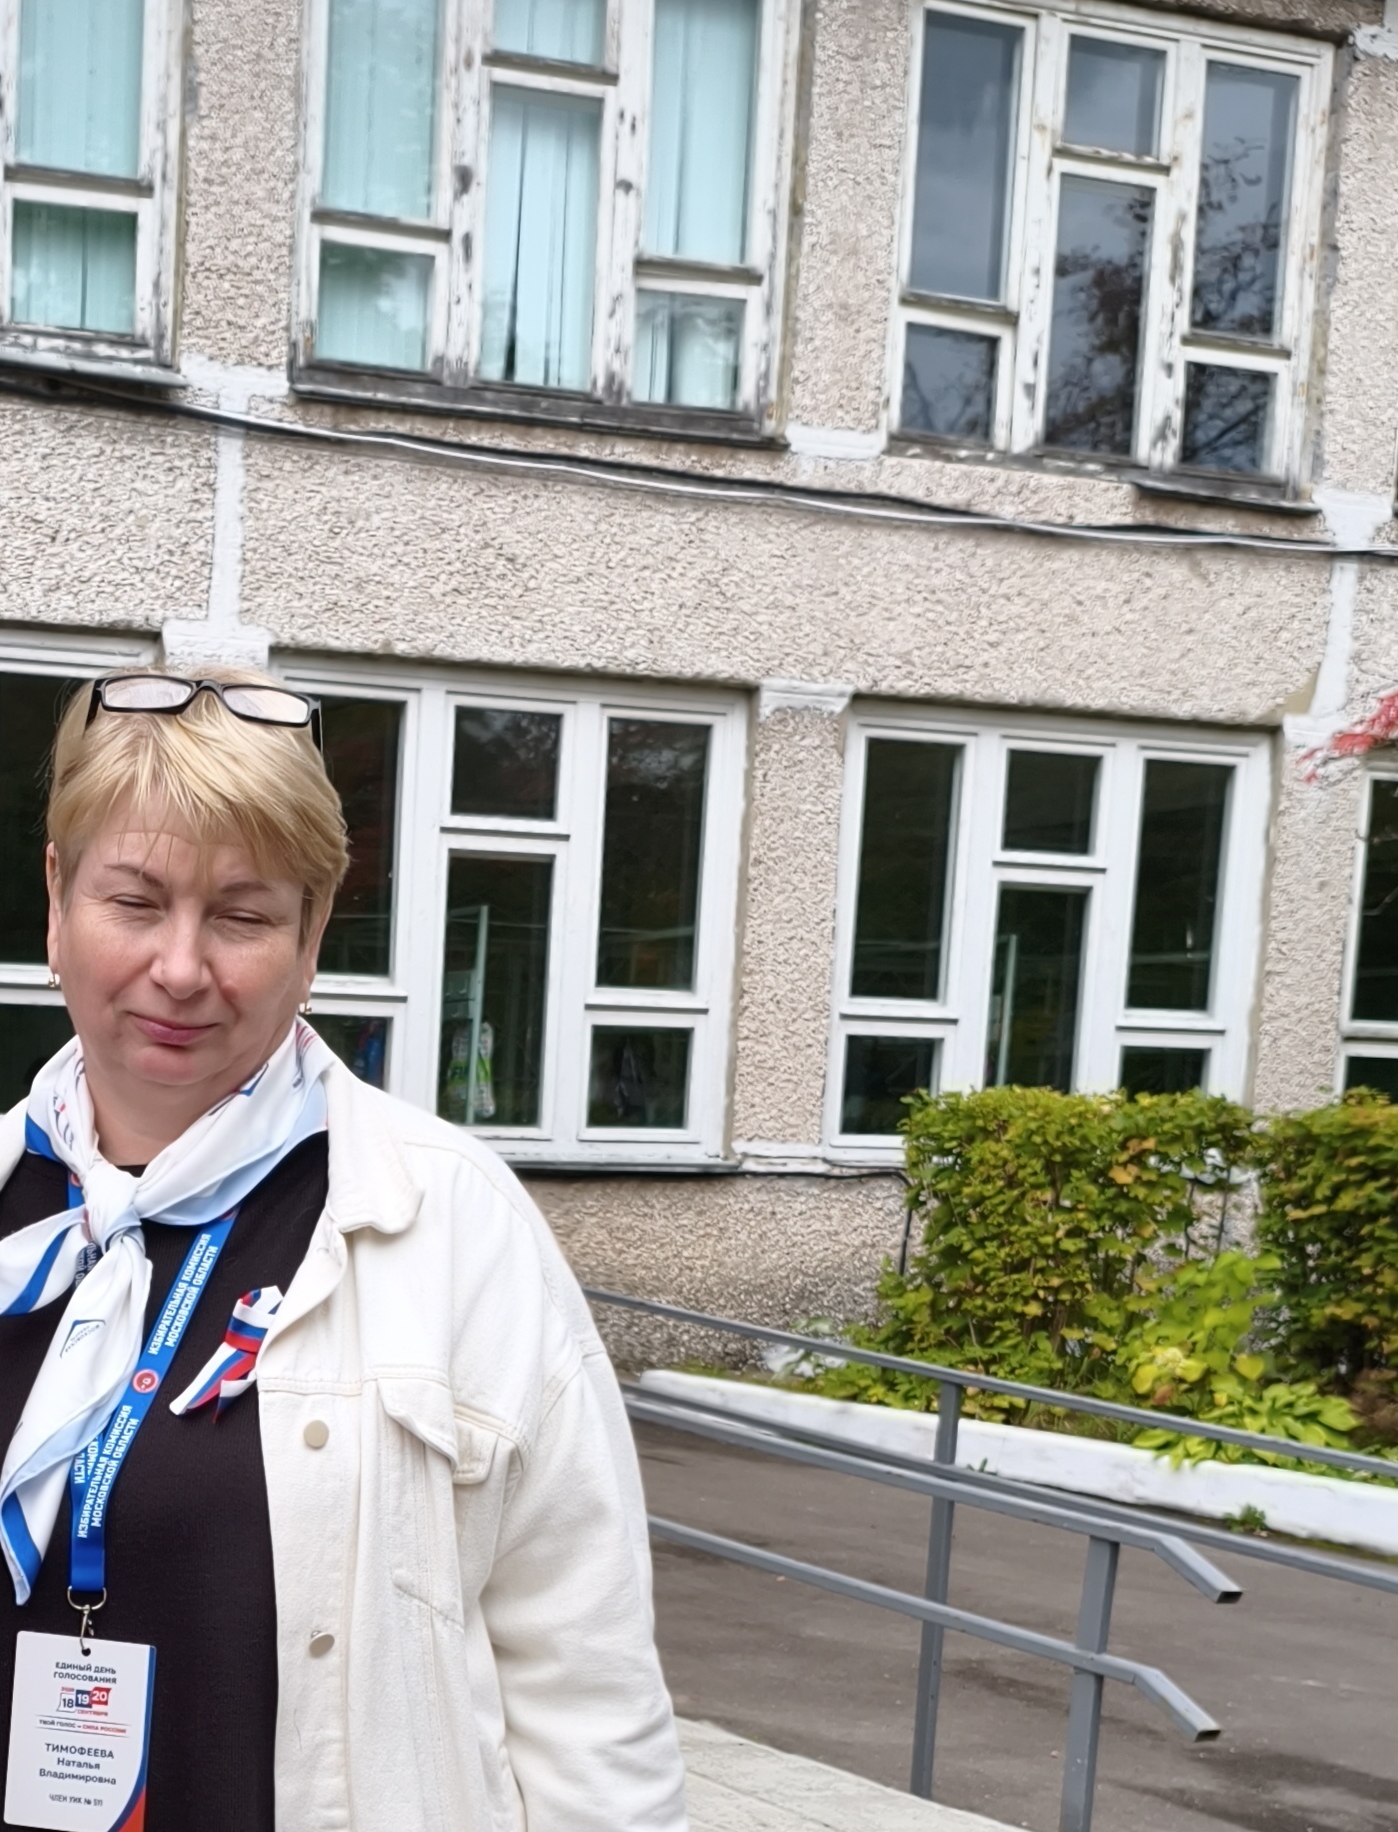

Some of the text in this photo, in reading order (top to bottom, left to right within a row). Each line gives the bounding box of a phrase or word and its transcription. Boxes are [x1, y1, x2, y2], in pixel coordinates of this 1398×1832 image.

[148, 1233, 212, 1356] ИЗБИРАТЕЛЬНАЯ КОМИССИЯ
[164, 1245, 219, 1348] МОСКОВСКОЙ ОБЛАСТИ
[77, 1405, 133, 1539] ИЗБИРАТЕЛЬНАЯ КОМИССИЯ
[90, 1418, 140, 1528] МОСКОВСКОЙ ОБЛАСТИ
[55, 1661, 116, 1675] ЕДИНЫЙ ДЕНЬ
[54, 1671, 117, 1684] ГОЛОСОВАНИЯ
[62, 1690, 108, 1708] 18 19 20
[45, 1743, 114, 1759] ТИМОФЕЕВА
[57, 1757, 100, 1770] Наталья
[39, 1768, 117, 1785] Владимировна
[49, 1793, 67, 1803] ЧЛЕН
[69, 1796, 82, 1804] УИК
